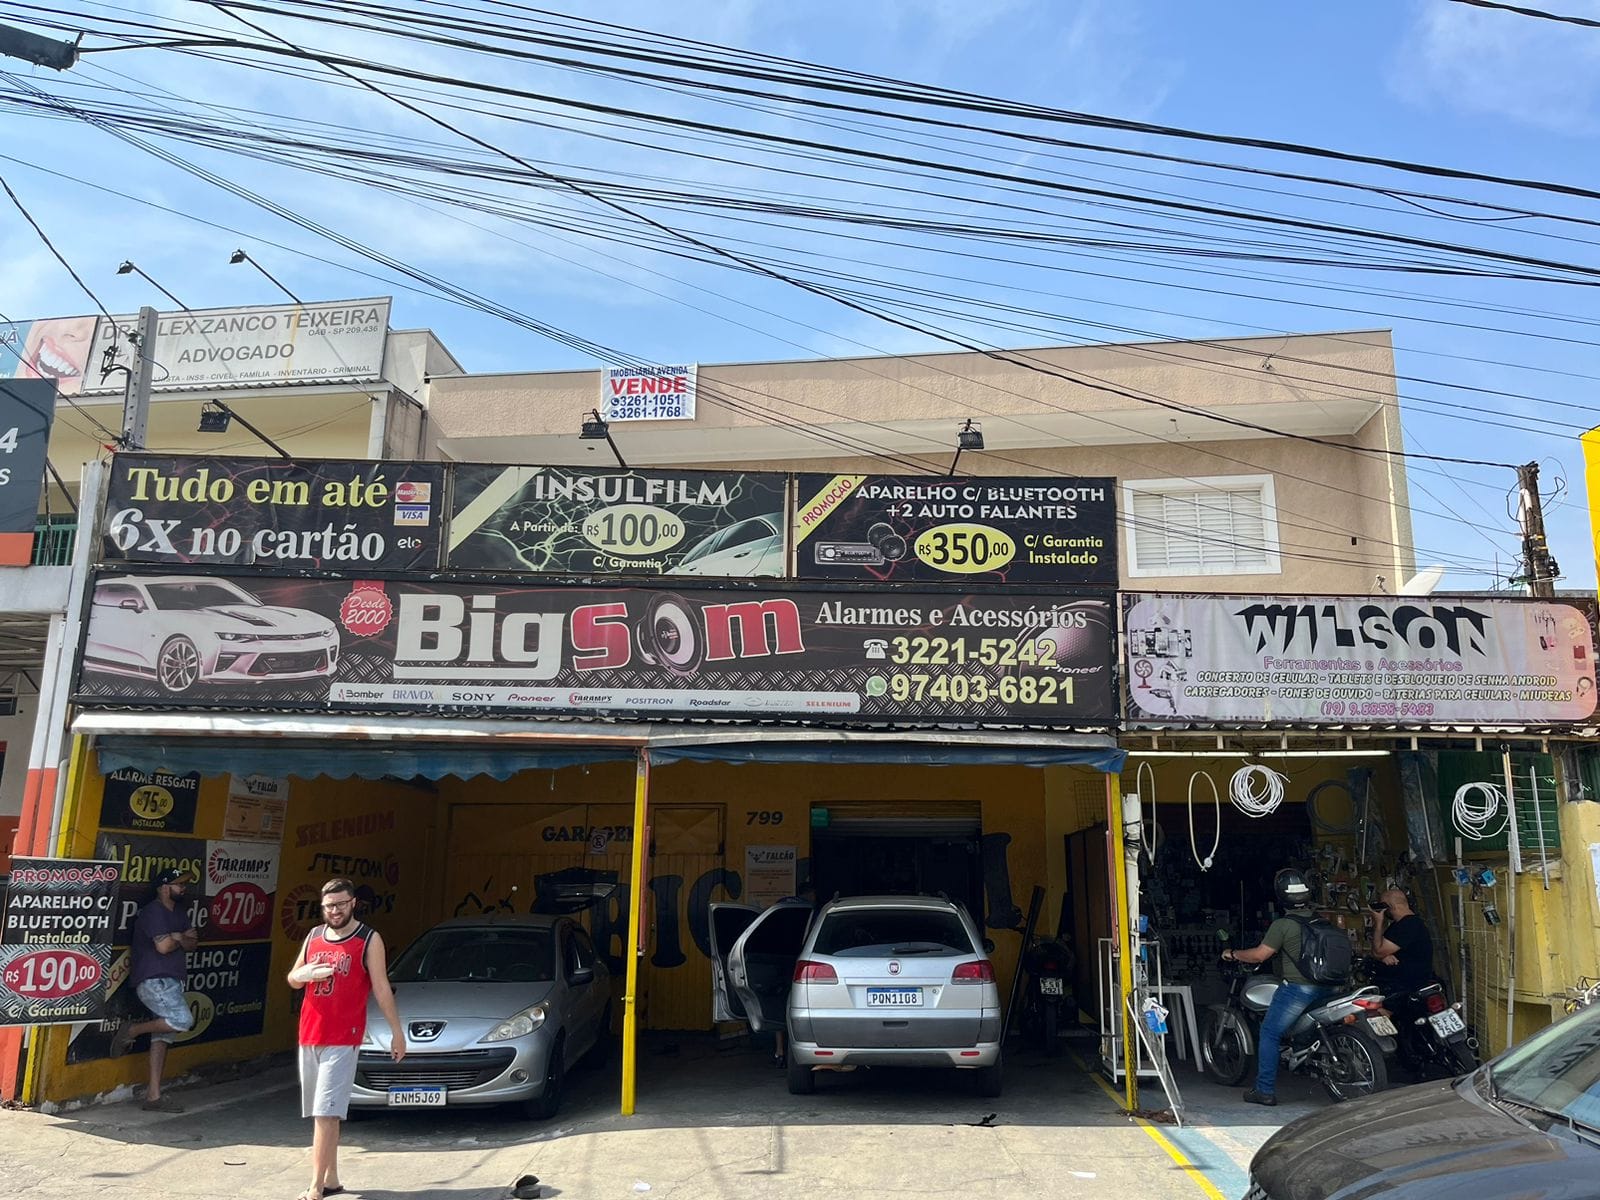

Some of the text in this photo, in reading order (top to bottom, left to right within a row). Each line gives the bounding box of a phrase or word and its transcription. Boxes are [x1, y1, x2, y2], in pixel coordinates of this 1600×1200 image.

[157, 319, 197, 336] LEX
[200, 314, 277, 334] ZANCO
[283, 307, 380, 329] TEIXEIRA
[346, 325, 378, 334] 209.436
[177, 343, 295, 363] ADVOGADO
[333, 365, 371, 374] CRIMINAL
[657, 366, 688, 375] AVENIDA
[611, 377, 687, 395] VENDE
[620, 394, 680, 406] 3261-1051
[620, 406, 681, 418] 3261-1768
[128, 467, 388, 508] Tudo em até
[535, 475, 730, 505] INSULFILM
[856, 486, 1105, 502] APARELHO C/ BLUETOOTH
[402, 511, 423, 519] VISA
[920, 504, 973, 519] AUTO
[980, 505, 1077, 519] FALANTES
[510, 523, 520, 532] A
[524, 522, 556, 533] Partir
[586, 513, 678, 547] R$ 100,00
[191, 526, 241, 556] no
[253, 522, 386, 562] cartão
[397, 536, 422, 549] elo
[918, 532, 1008, 566] R$ 350,00
[1024, 535, 1103, 549] C/ Garantia
[593, 556, 662, 569] C/ Garantia
[1029, 551, 1098, 564] Instalado
[349, 596, 385, 610] Desde
[344, 609, 387, 625] 2000
[815, 602, 1088, 629] Alarmes e Acessórios
[1234, 604, 1492, 657] WILSON
[891, 636, 1057, 667] 3221-5242
[1045, 663, 1103, 675] Pioneer
[1264, 656, 1463, 672] Ferramentas e Acessórios
[1197, 671, 1253, 684] CONCERTO
[1256, 672, 1271, 683] DE
[1272, 672, 1318, 684] CELULAR
[1328, 673, 1373, 685] TABLETS
[1374, 674, 1383, 685] E
[1385, 674, 1456, 686] DESBLOQUEIO
[1456, 675, 1473, 686] DE
[1475, 675, 1510, 686] SENHA
[1511, 675, 1557, 687] ANDROID
[346, 689, 384, 699] Bomber
[393, 690, 434, 700] BRAVOX
[452, 692, 495, 701] SONY
[891, 674, 1074, 704] 97403-6821
[1184, 686, 1270, 698] CARREGADORES
[1279, 687, 1313, 698] FONES
[1316, 688, 1330, 699] DE
[1332, 688, 1374, 699] OUVIDO
[1382, 689, 1432, 700] BATERIAS
[1433, 689, 1461, 700] PARA
[1464, 689, 1511, 701] CELULAR
[508, 693, 555, 702] Pioneer
[689, 699, 731, 707] Roadstar
[1321, 700, 1346, 716] (19)
[110, 770, 198, 790] ALARME RESGATE
[132, 817, 165, 829] INSTALADO
[746, 810, 784, 826] 799
[295, 810, 394, 848] SELENIUM
[766, 850, 794, 861] FALCÃO
[307, 853, 382, 878] STETSOM
[12, 865, 118, 885] PROMOÇÃO
[9, 895, 114, 911] APARELHO C/
[8, 915, 109, 929] BLUETOOTH
[24, 931, 90, 944] Instalado
[186, 948, 245, 969] ELHO C/
[5, 956, 96, 992] R$ 190,00
[8, 1003, 88, 1019] C/ Garantia
[394, 1092, 441, 1104] ENM5J69
